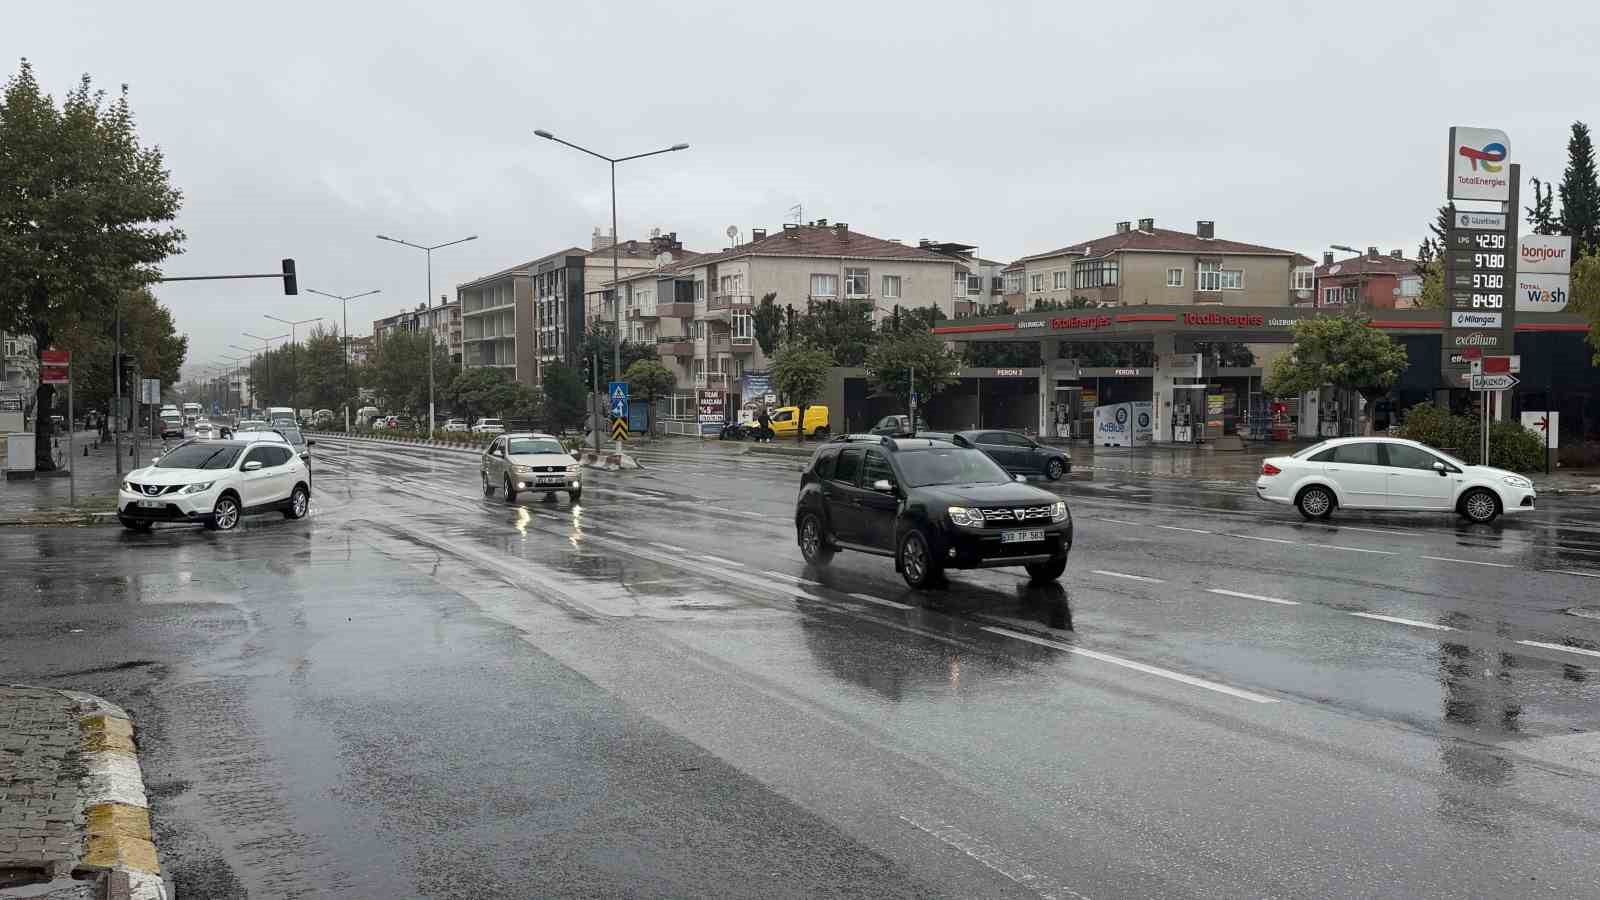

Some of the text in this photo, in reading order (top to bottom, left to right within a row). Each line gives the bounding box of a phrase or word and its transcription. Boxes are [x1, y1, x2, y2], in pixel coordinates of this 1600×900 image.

[1458, 176, 1506, 187] TotalEnergies
[1457, 236, 1470, 244] LPG
[1521, 244, 1566, 261] bonjour
[1528, 288, 1566, 304] wash
[1049, 315, 1112, 330] TotalEnergies
[1183, 311, 1264, 328] TotalEnergies
[1464, 314, 1496, 326] Milangaz
[1455, 333, 1497, 346] excellium
[1099, 422, 1125, 433] AdBlue
